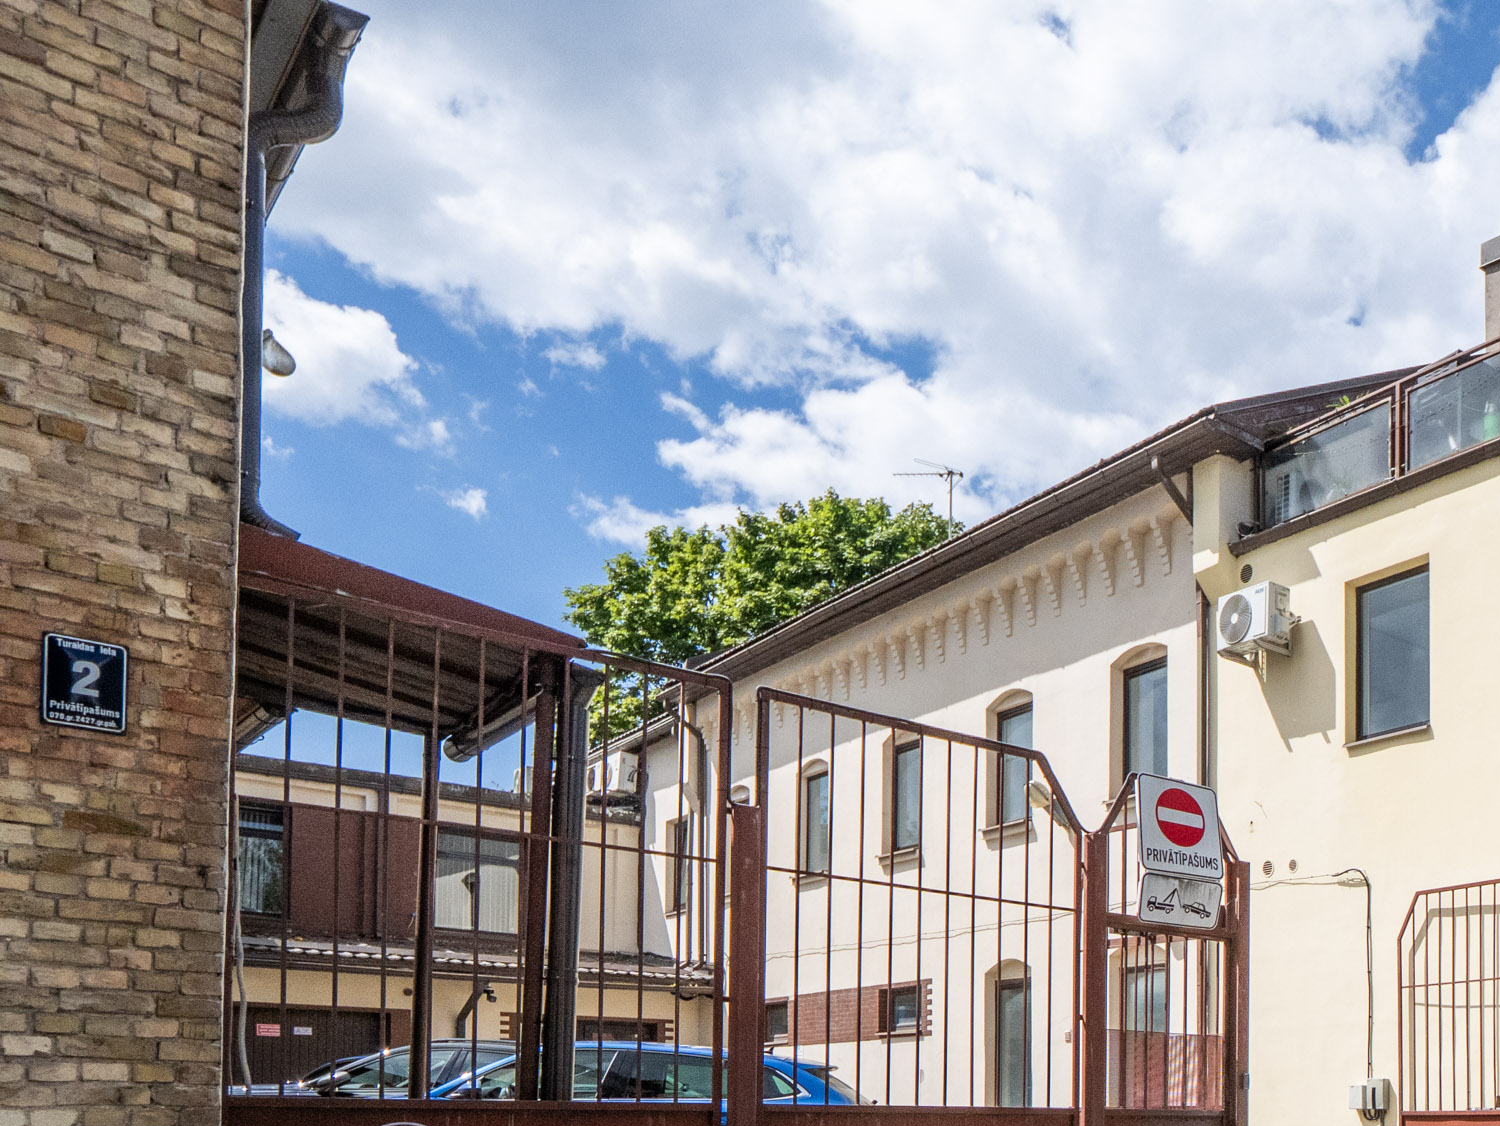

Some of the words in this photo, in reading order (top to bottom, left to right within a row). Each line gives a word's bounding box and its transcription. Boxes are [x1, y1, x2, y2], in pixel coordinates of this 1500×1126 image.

[56, 638, 95, 653] Turaidas
[71, 660, 100, 698] 2
[49, 699, 121, 719] Privātīpašums
[1146, 847, 1219, 871] PRIVĀTĪPAŠUMS
